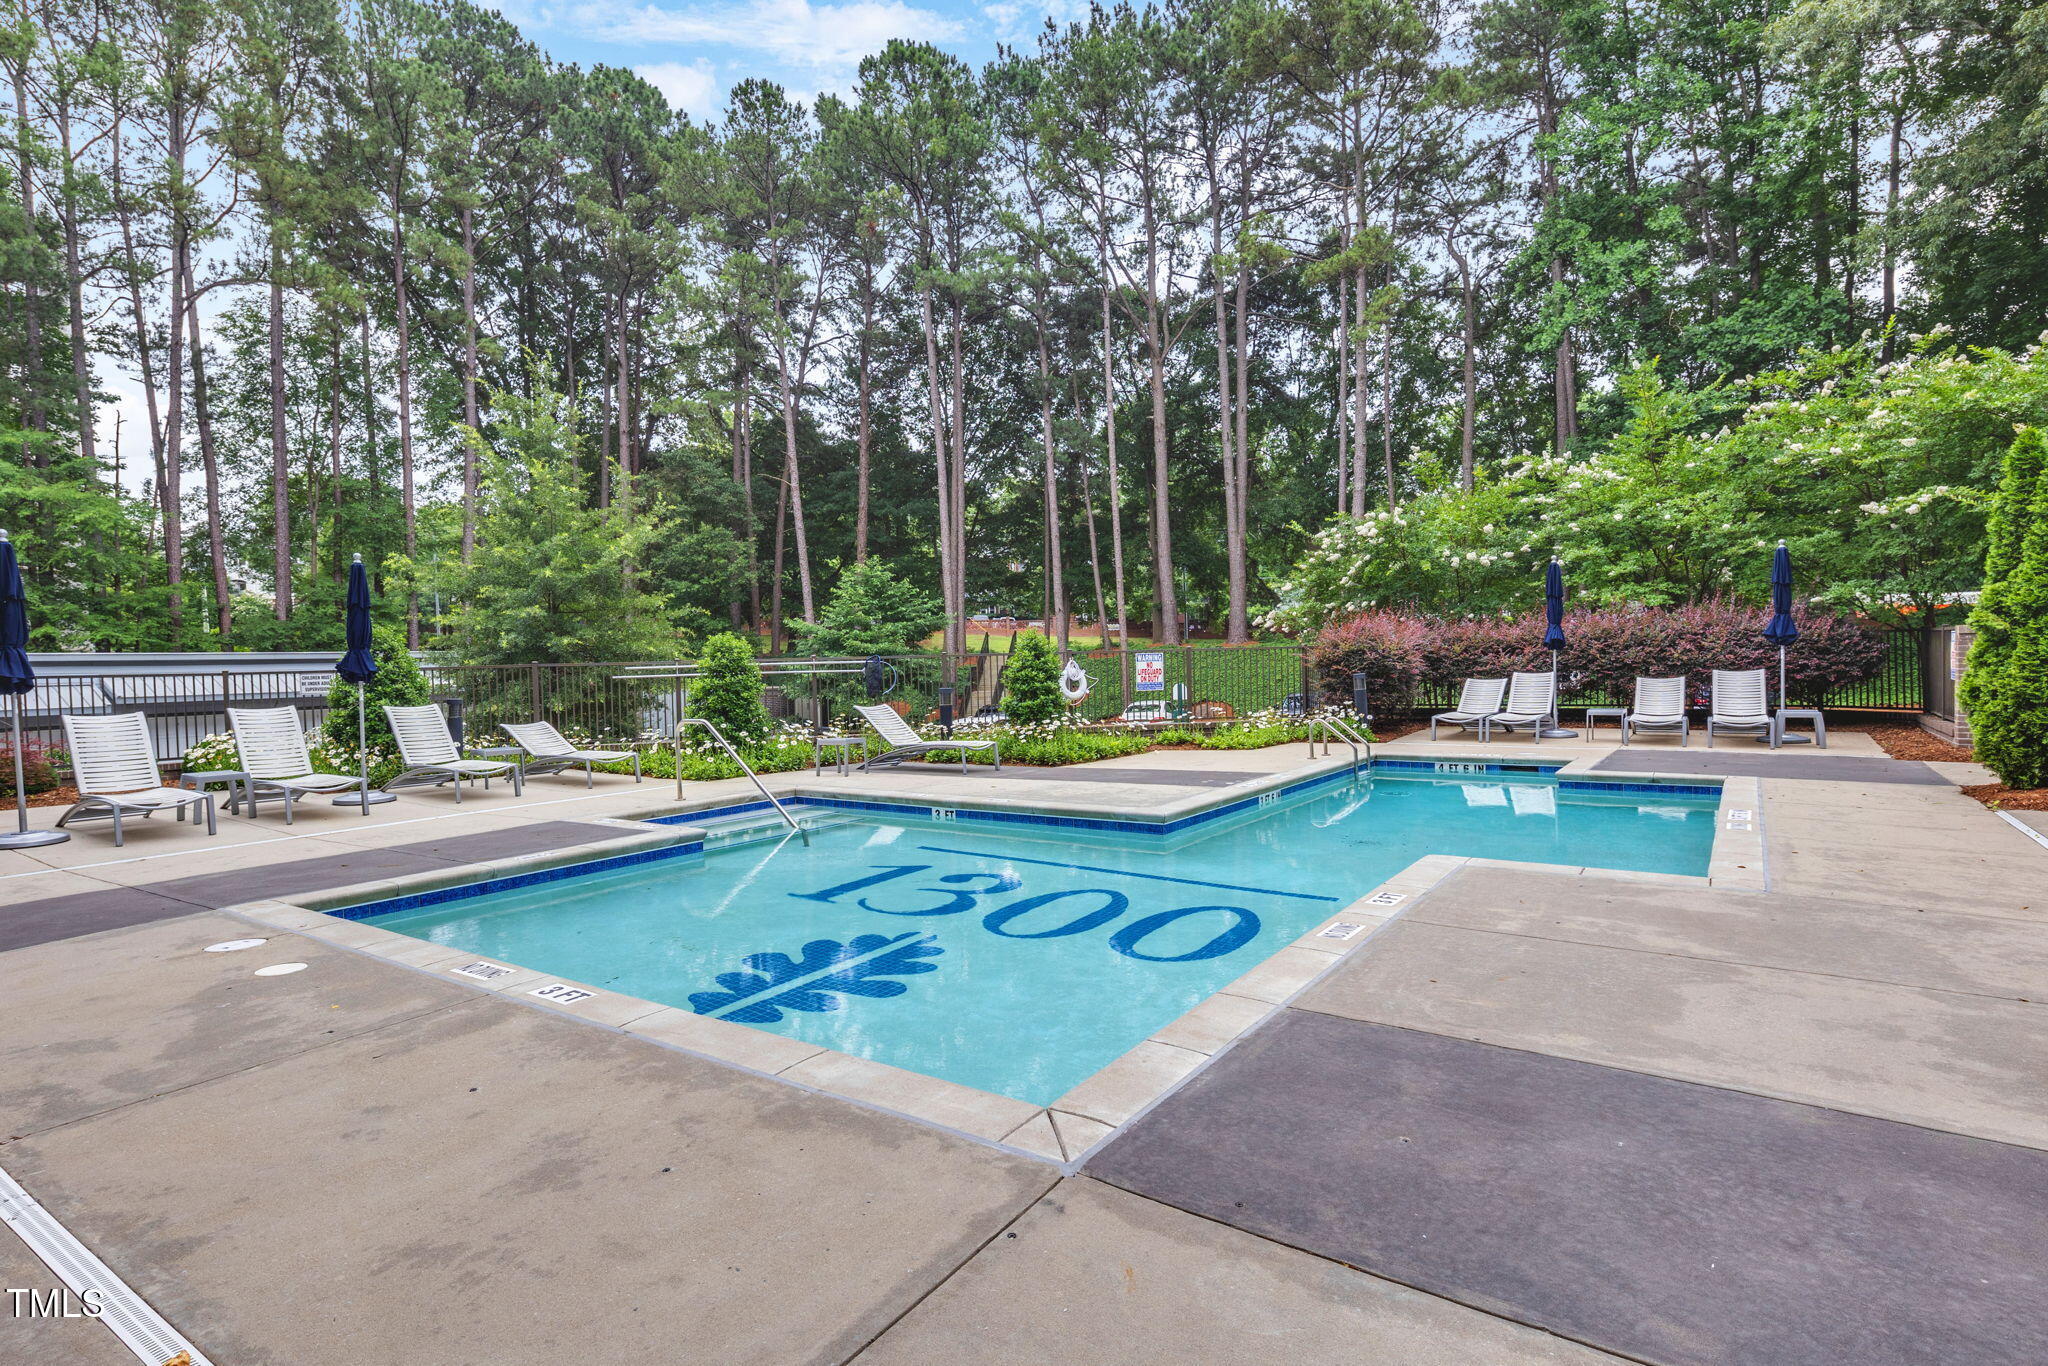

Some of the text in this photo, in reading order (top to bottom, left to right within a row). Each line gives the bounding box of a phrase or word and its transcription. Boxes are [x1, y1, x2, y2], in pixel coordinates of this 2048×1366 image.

[1137, 654, 1163, 662] WARNING
[1474, 764, 1484, 774] IN
[787, 864, 1262, 963] 1300
[537, 986, 592, 1002] 3 FT
